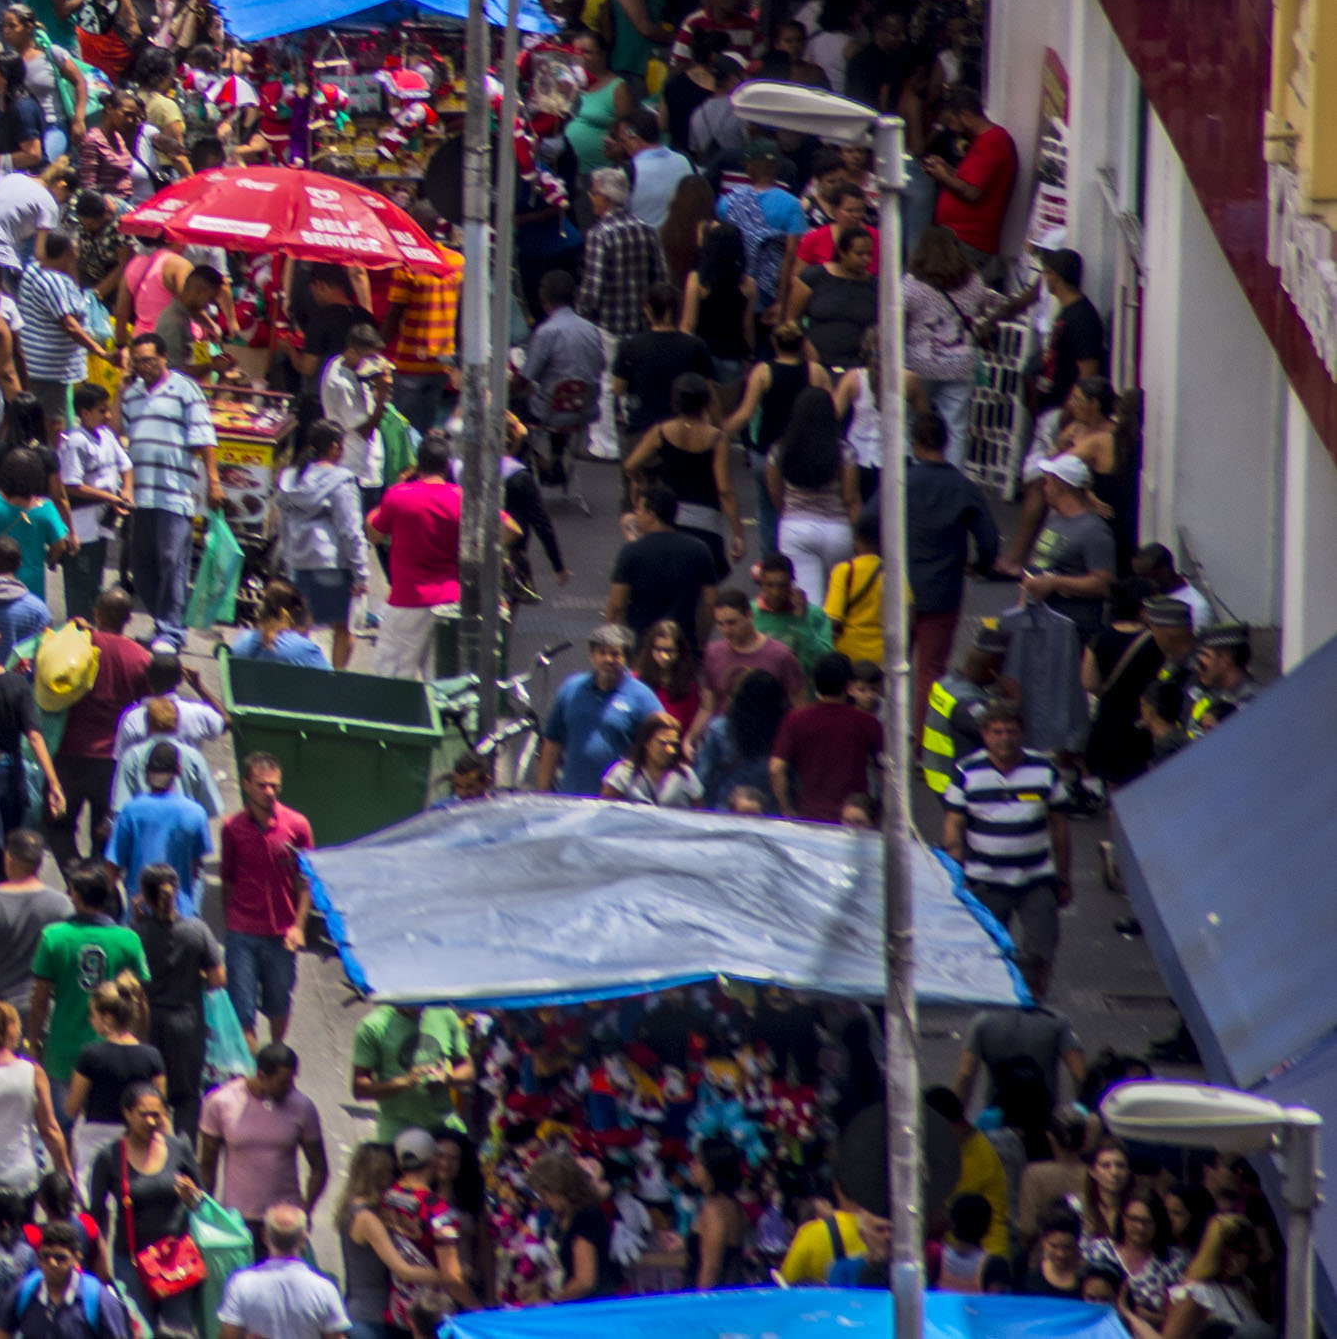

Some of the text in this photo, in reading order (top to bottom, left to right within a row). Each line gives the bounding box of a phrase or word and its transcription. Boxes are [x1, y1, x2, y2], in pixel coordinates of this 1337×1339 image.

[309, 217, 362, 235] SELF
[300, 231, 383, 253] SERVICE
[77, 943, 106, 993] 9
